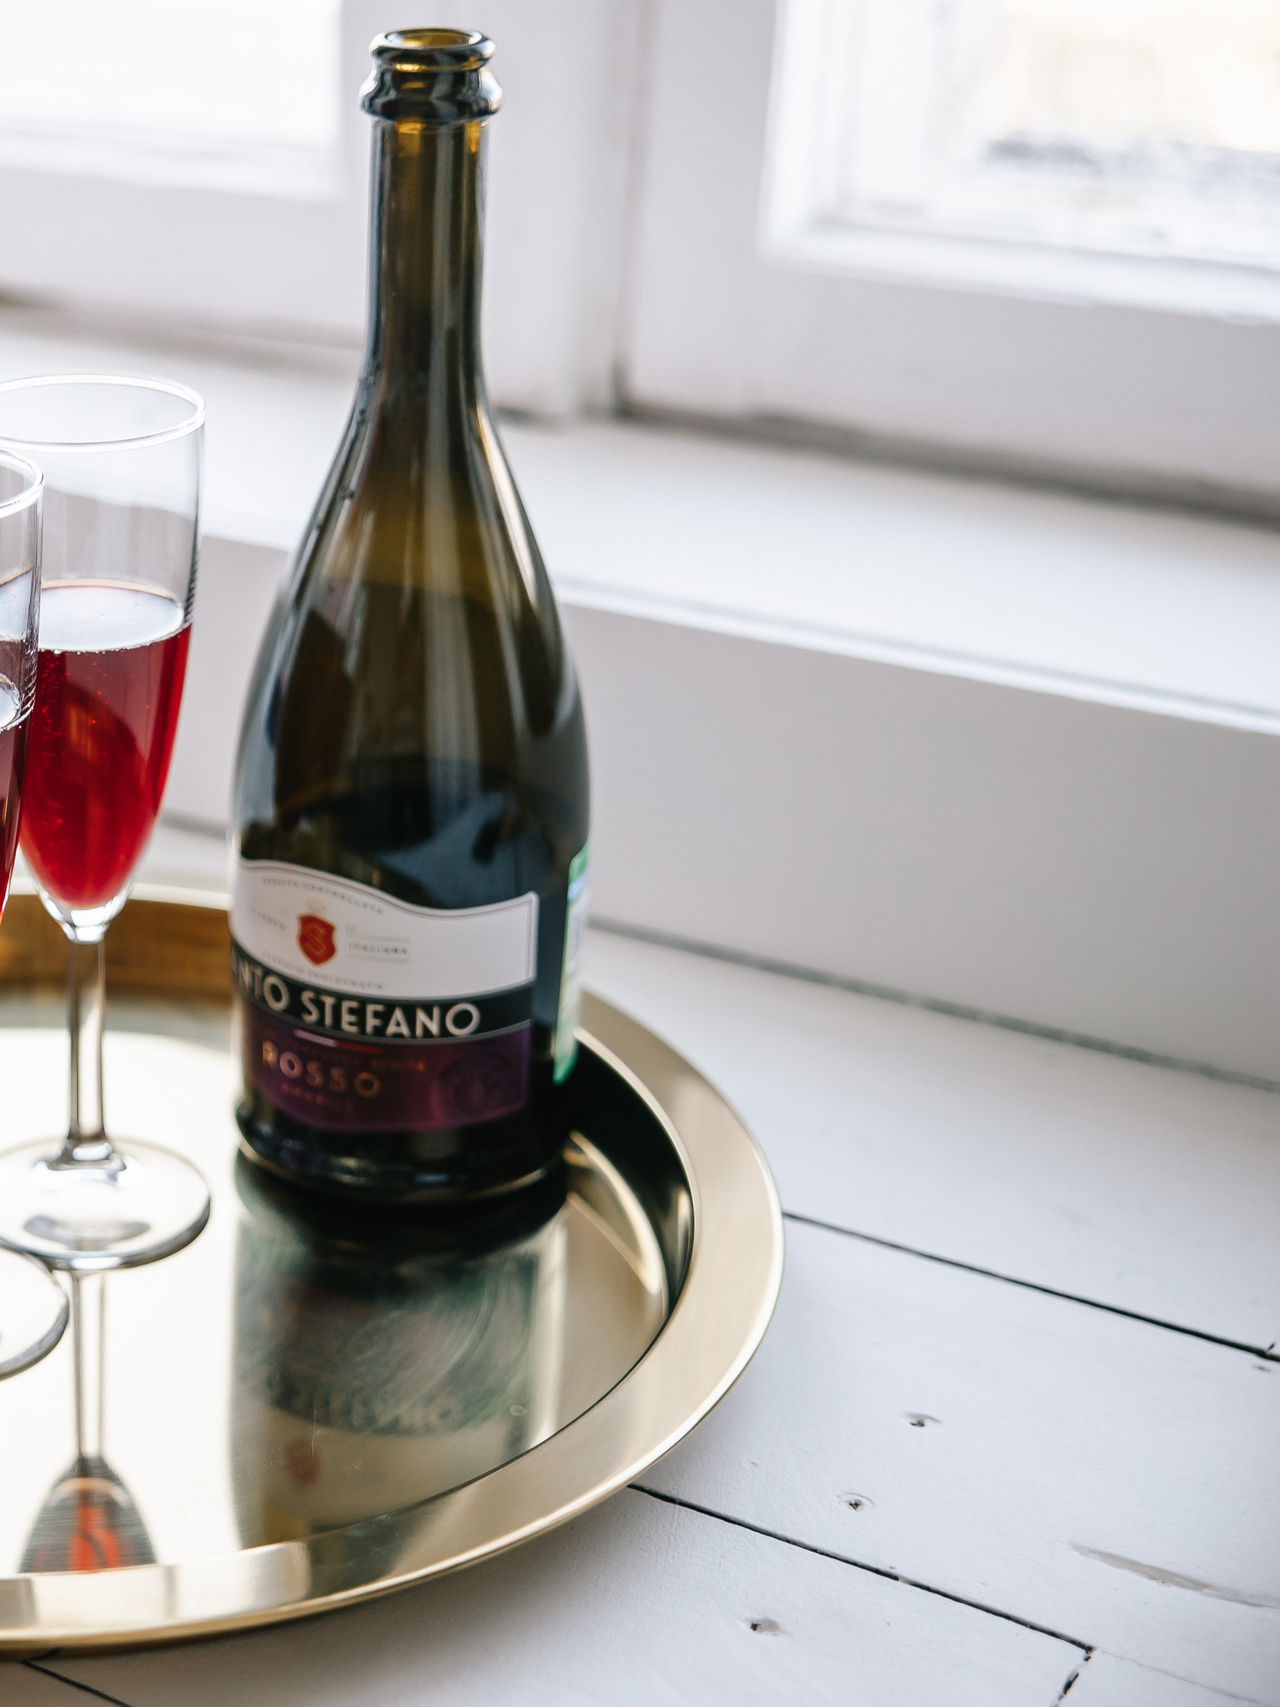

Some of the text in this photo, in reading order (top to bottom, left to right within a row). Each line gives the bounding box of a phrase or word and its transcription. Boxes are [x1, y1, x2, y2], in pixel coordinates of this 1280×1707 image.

[232, 948, 290, 1011] NTO
[300, 990, 481, 1038] STEFANO
[262, 1040, 381, 1098] ROSSO
